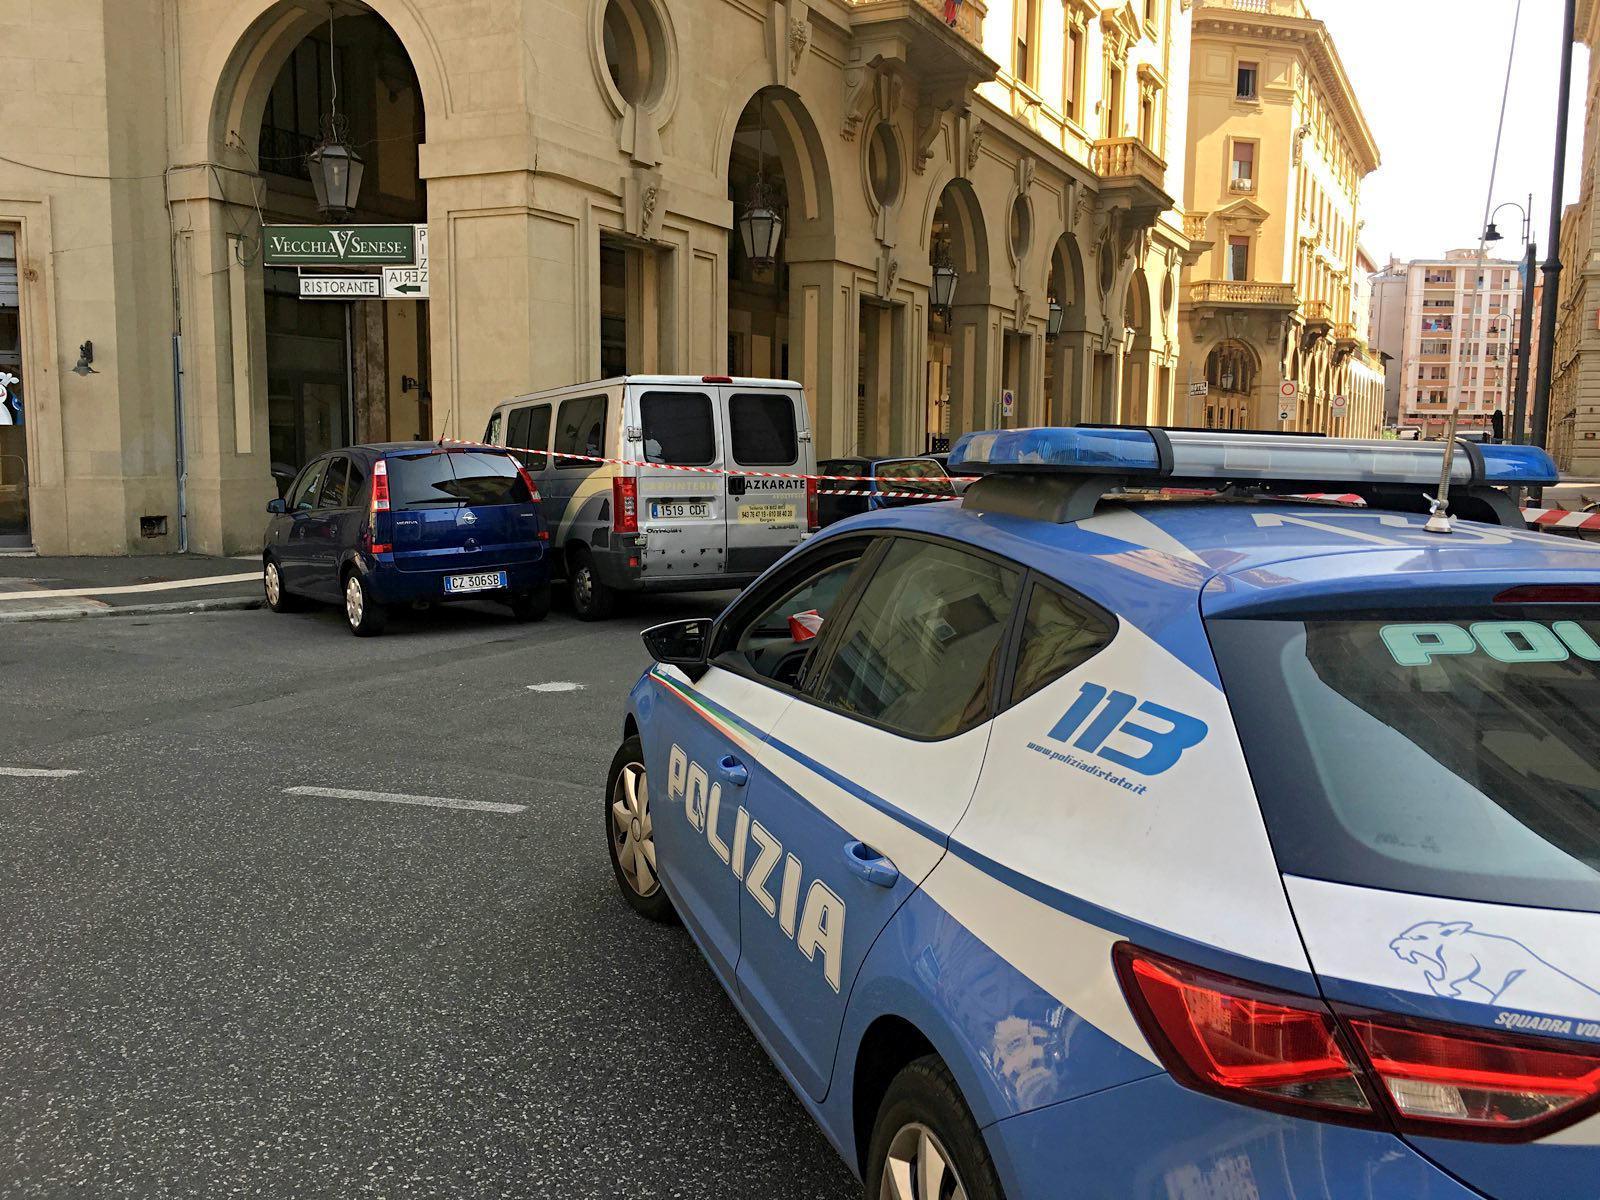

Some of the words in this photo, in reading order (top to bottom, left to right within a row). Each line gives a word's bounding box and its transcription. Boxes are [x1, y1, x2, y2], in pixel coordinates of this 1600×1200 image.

[271, 236, 337, 253] VECCHIA
[351, 236, 403, 253] SENESE
[304, 281, 375, 293] RISTORANTE
[745, 480, 805, 490] AZKARATE
[661, 505, 684, 516] 1519
[689, 505, 706, 516] CDT
[452, 577, 465, 588] CZ
[468, 574, 499, 587] 306SB
[1046, 681, 1209, 776] 113
[1025, 741, 1150, 796] www.poliziadistato.it
[667, 743, 846, 994] POLIZIA
[1494, 1011, 1572, 1034] SQUADRA
[1576, 1022, 1600, 1038] VO
